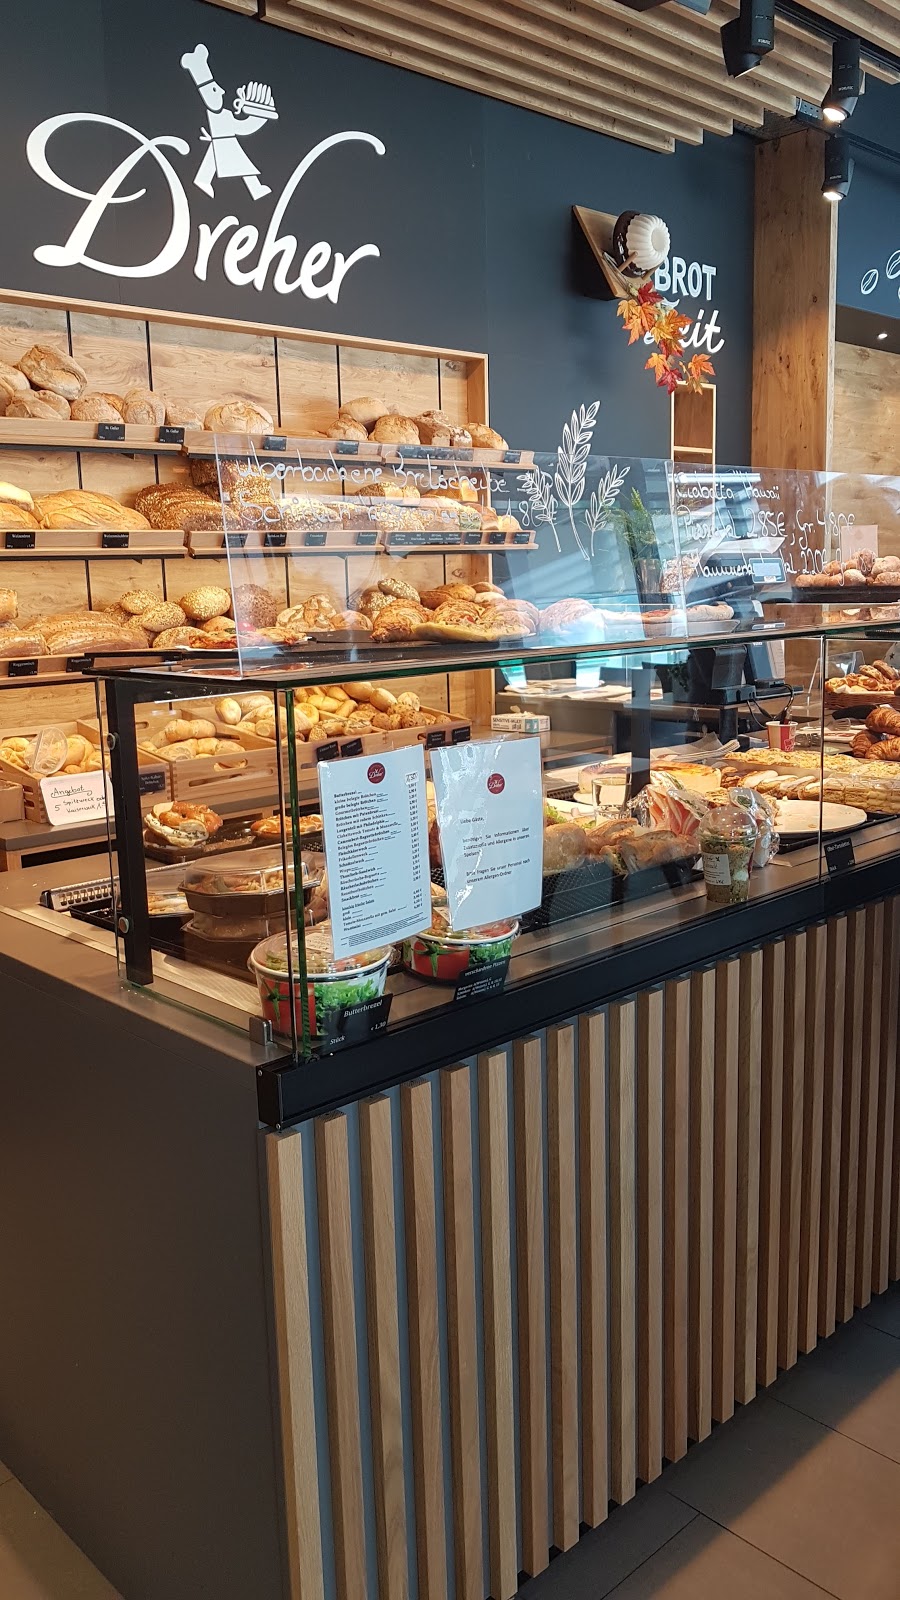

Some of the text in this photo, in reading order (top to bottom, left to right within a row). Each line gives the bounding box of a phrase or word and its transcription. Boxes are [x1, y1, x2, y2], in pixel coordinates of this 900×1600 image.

[26, 112, 386, 304] Dreher
[655, 256, 717, 301] BROT
[53, 785, 88, 798] Angebot
[343, 999, 383, 1018] Butterbrezel
[329, 1035, 346, 1045] Stück
